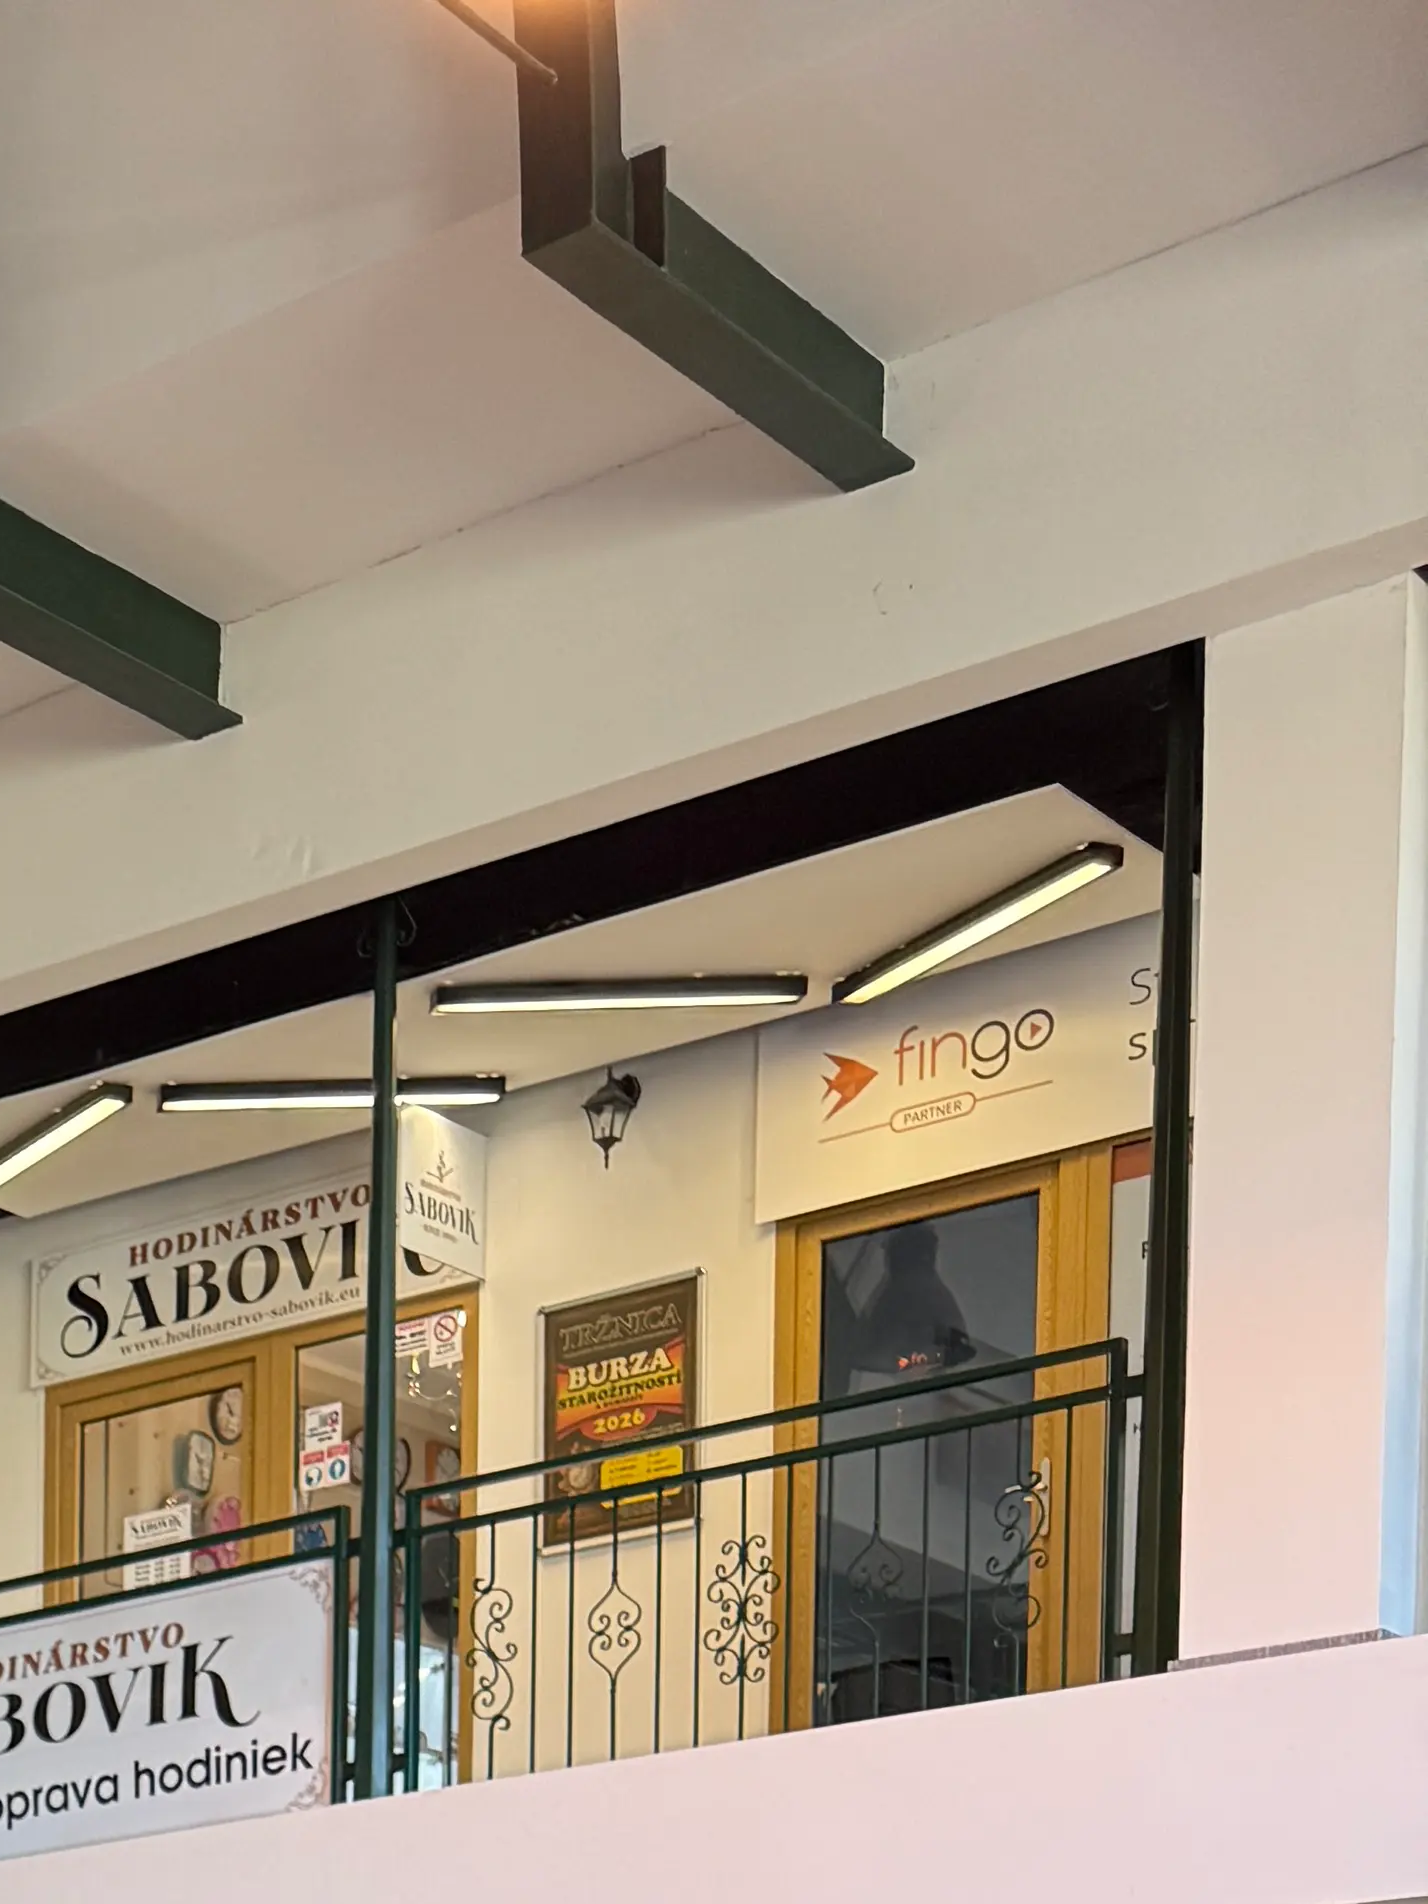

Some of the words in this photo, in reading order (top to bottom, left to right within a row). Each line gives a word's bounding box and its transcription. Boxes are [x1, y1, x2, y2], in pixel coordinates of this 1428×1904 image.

[893, 1008, 1055, 1080] fingo
[903, 1100, 963, 1126] PARTNER
[128, 1183, 371, 1268] HODINÁRSTVO
[60, 1219, 444, 1359] SABOVI
[567, 1347, 674, 1393] BURZA
[593, 1408, 646, 1435] 2026
[133, 1731, 314, 1800] hodiniek
